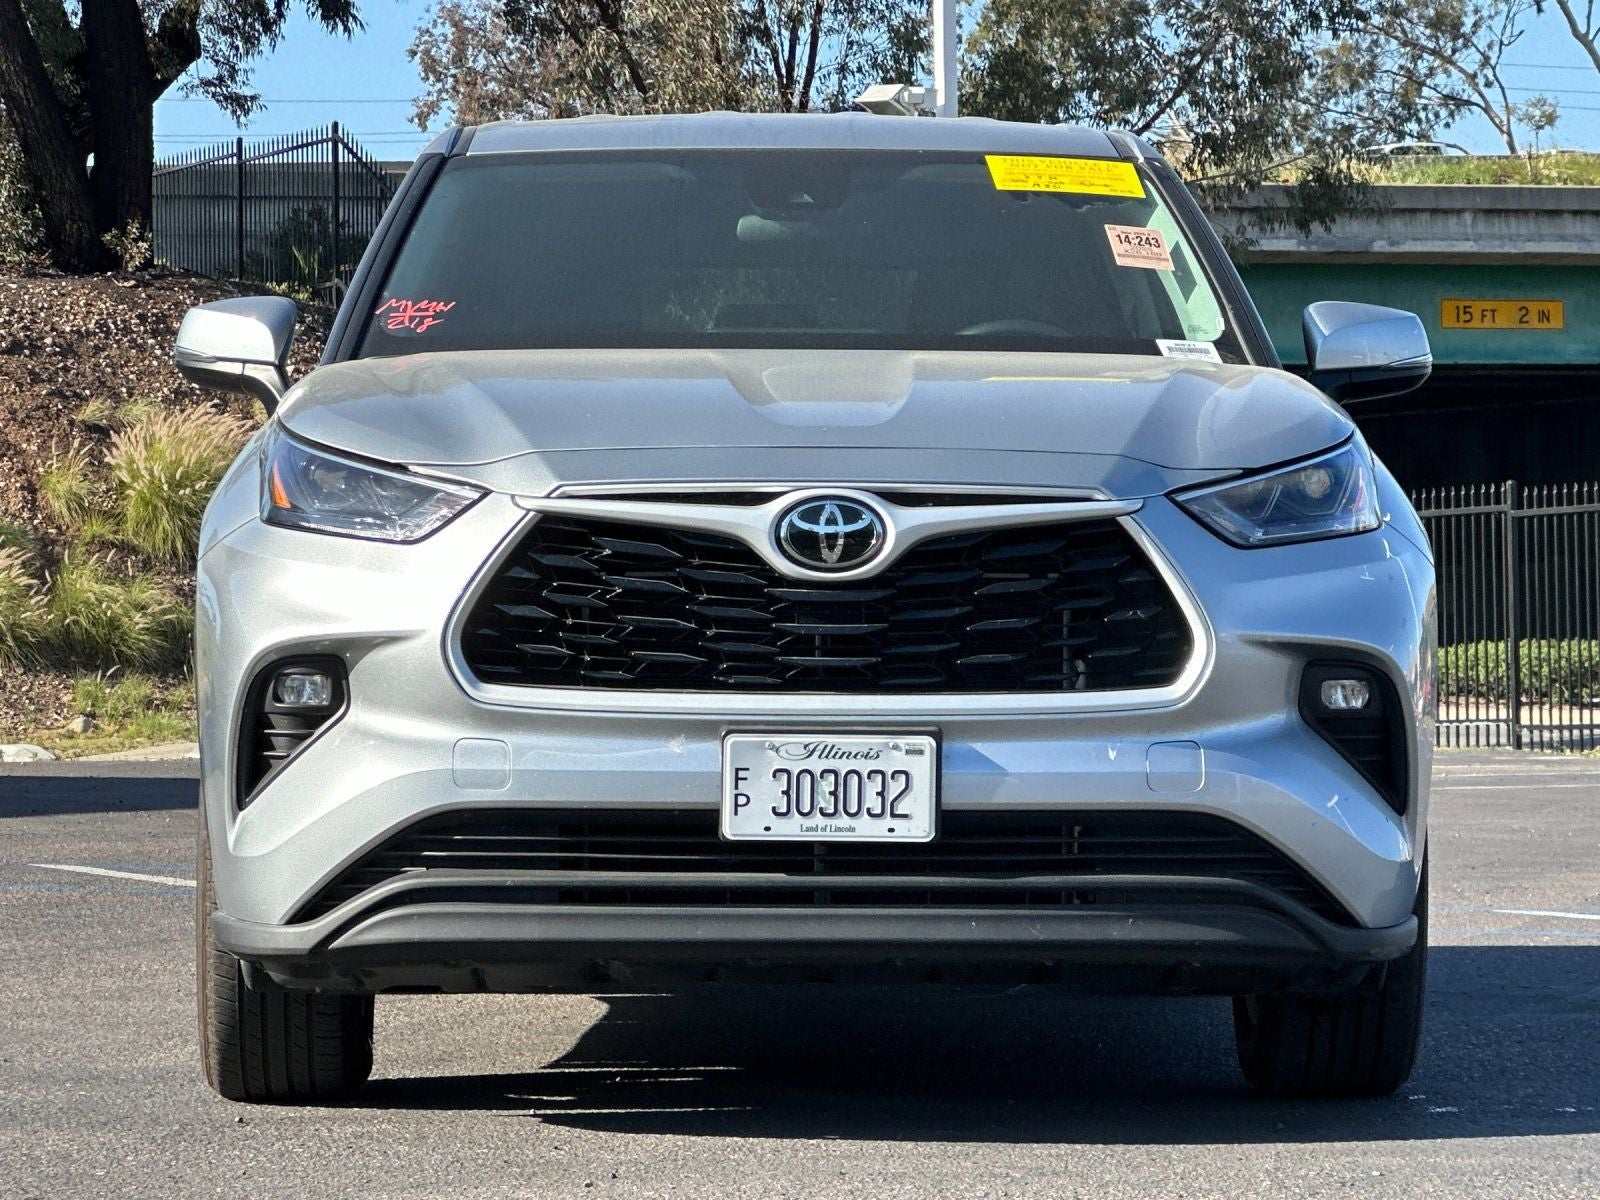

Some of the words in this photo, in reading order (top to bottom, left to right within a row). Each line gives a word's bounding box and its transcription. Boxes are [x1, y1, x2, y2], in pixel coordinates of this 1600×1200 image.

[1455, 305, 1474, 324] 15
[1481, 308, 1498, 323] FT
[1518, 306, 1530, 324] 2
[1537, 309, 1551, 324] IN
[775, 740, 883, 761] Illinois
[771, 767, 911, 818] 303032
[800, 823, 820, 833] Land
[821, 823, 829, 833] of
[829, 823, 856, 833] Lincoln
